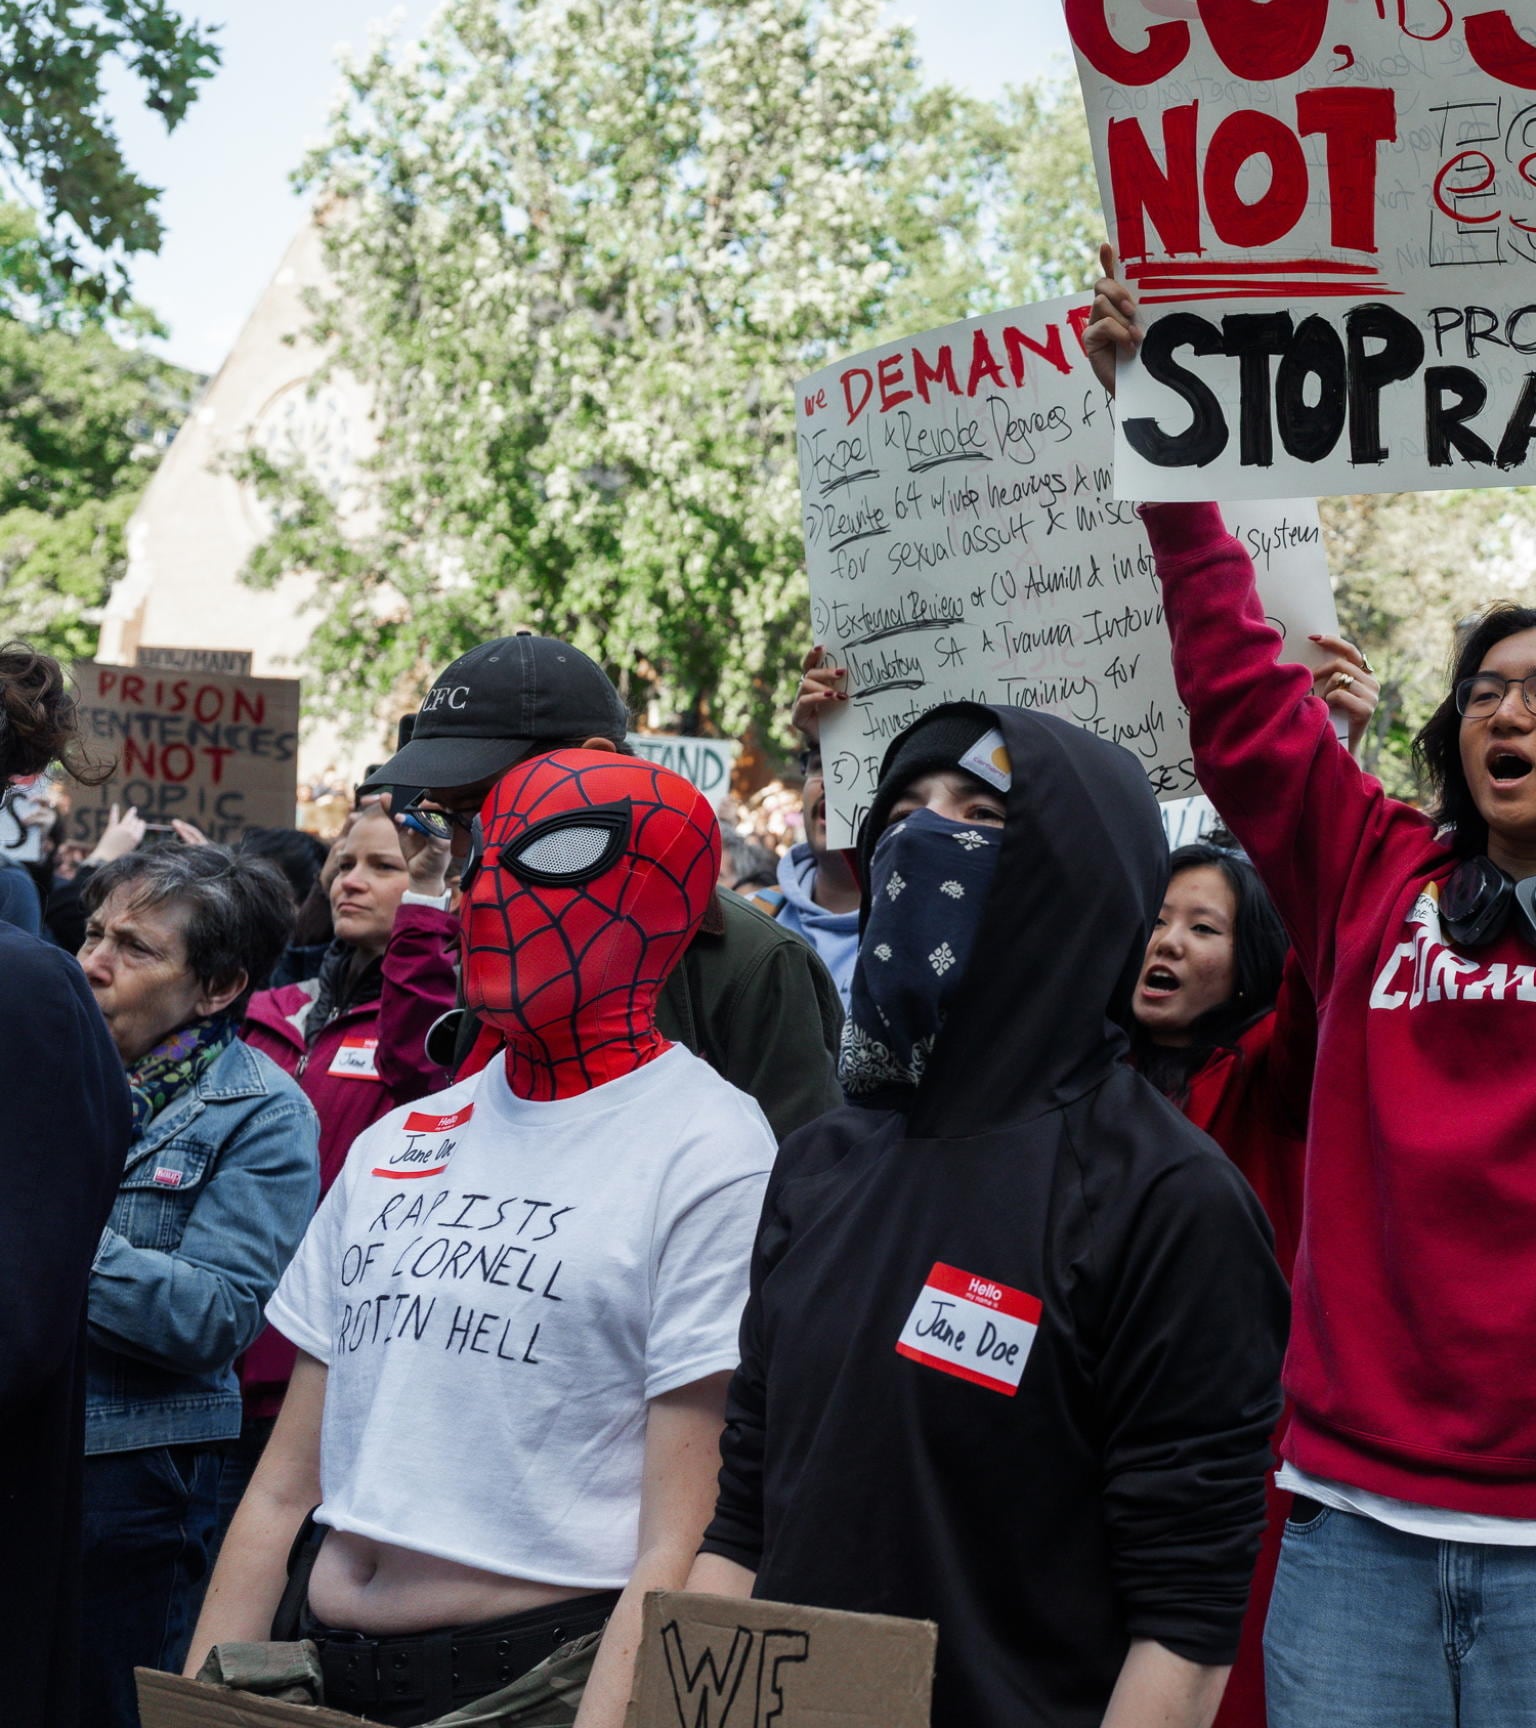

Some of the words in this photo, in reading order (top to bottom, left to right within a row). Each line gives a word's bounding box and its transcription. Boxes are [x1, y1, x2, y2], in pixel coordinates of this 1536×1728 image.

[1108, 87, 1398, 263] NOT
[803, 387, 828, 417] we
[1121, 302, 1425, 469] STOP
[897, 407, 987, 462] Revoke
[830, 548, 870, 580] for
[888, 526, 957, 575] sexual
[813, 598, 832, 636] 3)
[98, 671, 266, 725] PRISON
[79, 706, 298, 762] ENTENCES
[123, 737, 235, 785] NOT
[98, 778, 247, 824] TOPIC
[389, 1133, 433, 1165] Jane
[368, 1190, 578, 1242] RAPISTS
[341, 1242, 385, 1287] OF
[391, 1236, 564, 1302] CORNELL
[968, 1277, 1003, 1301] Hello
[445, 1305, 542, 1365] HELL
[915, 1300, 966, 1352] Jane
[976, 1320, 1020, 1367] Doe
